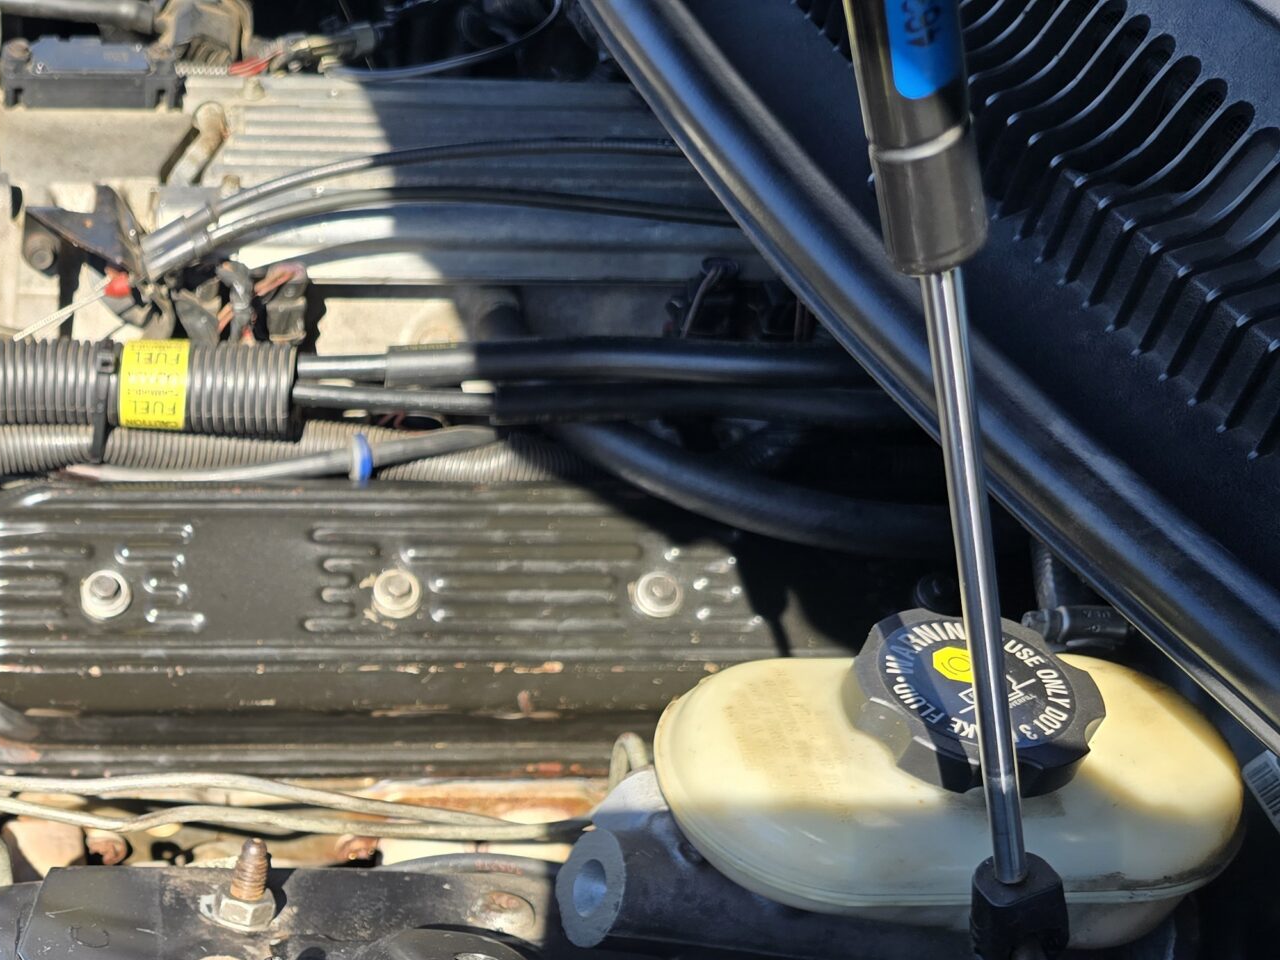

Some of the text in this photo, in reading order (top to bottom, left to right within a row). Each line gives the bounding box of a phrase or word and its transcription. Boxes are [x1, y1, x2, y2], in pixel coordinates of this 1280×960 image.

[886, 621, 967, 675] WARNIN
[892, 682, 945, 725] FLUID
[1003, 639, 1071, 741] USE ONLY DOT 3
